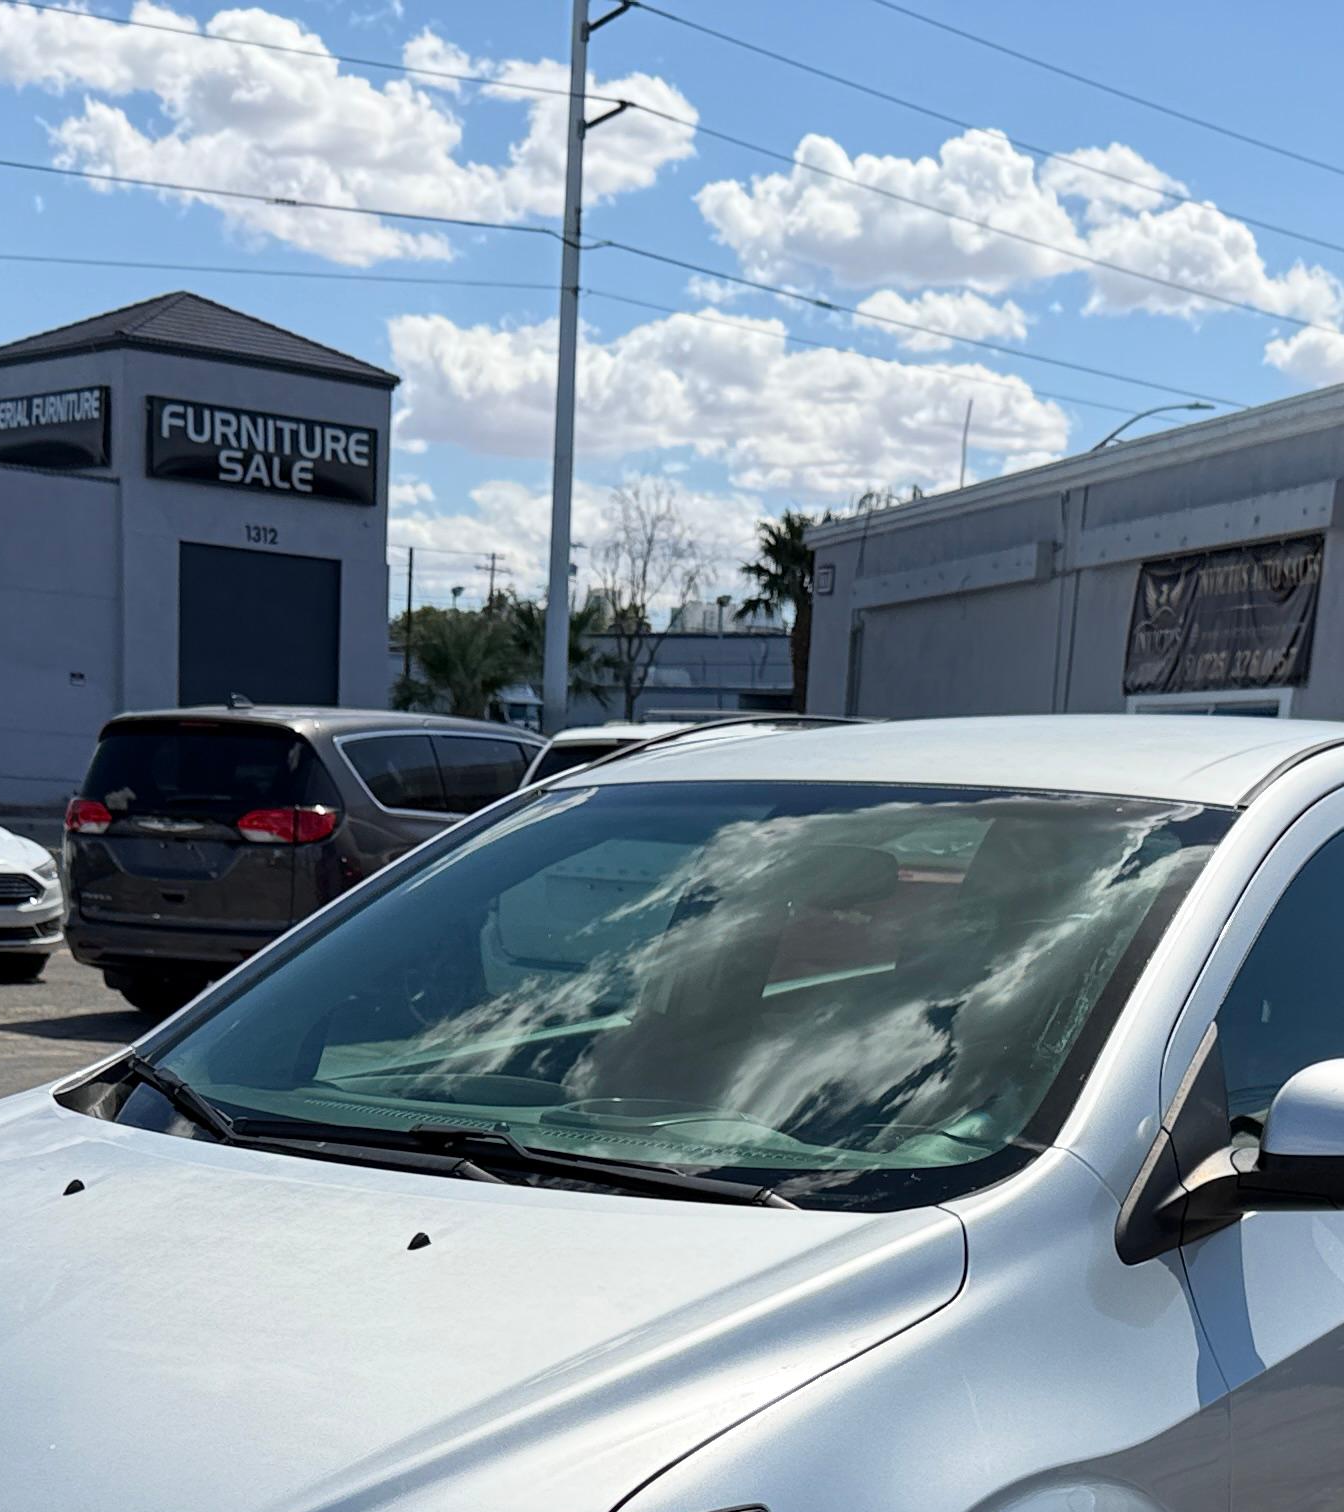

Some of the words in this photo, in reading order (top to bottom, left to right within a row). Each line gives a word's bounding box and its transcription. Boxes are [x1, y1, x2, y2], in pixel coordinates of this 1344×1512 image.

[31, 389, 101, 426] FURNITURE
[161, 404, 370, 467] FURNITURE
[218, 449, 315, 493] SALE
[245, 525, 279, 546] 1312
